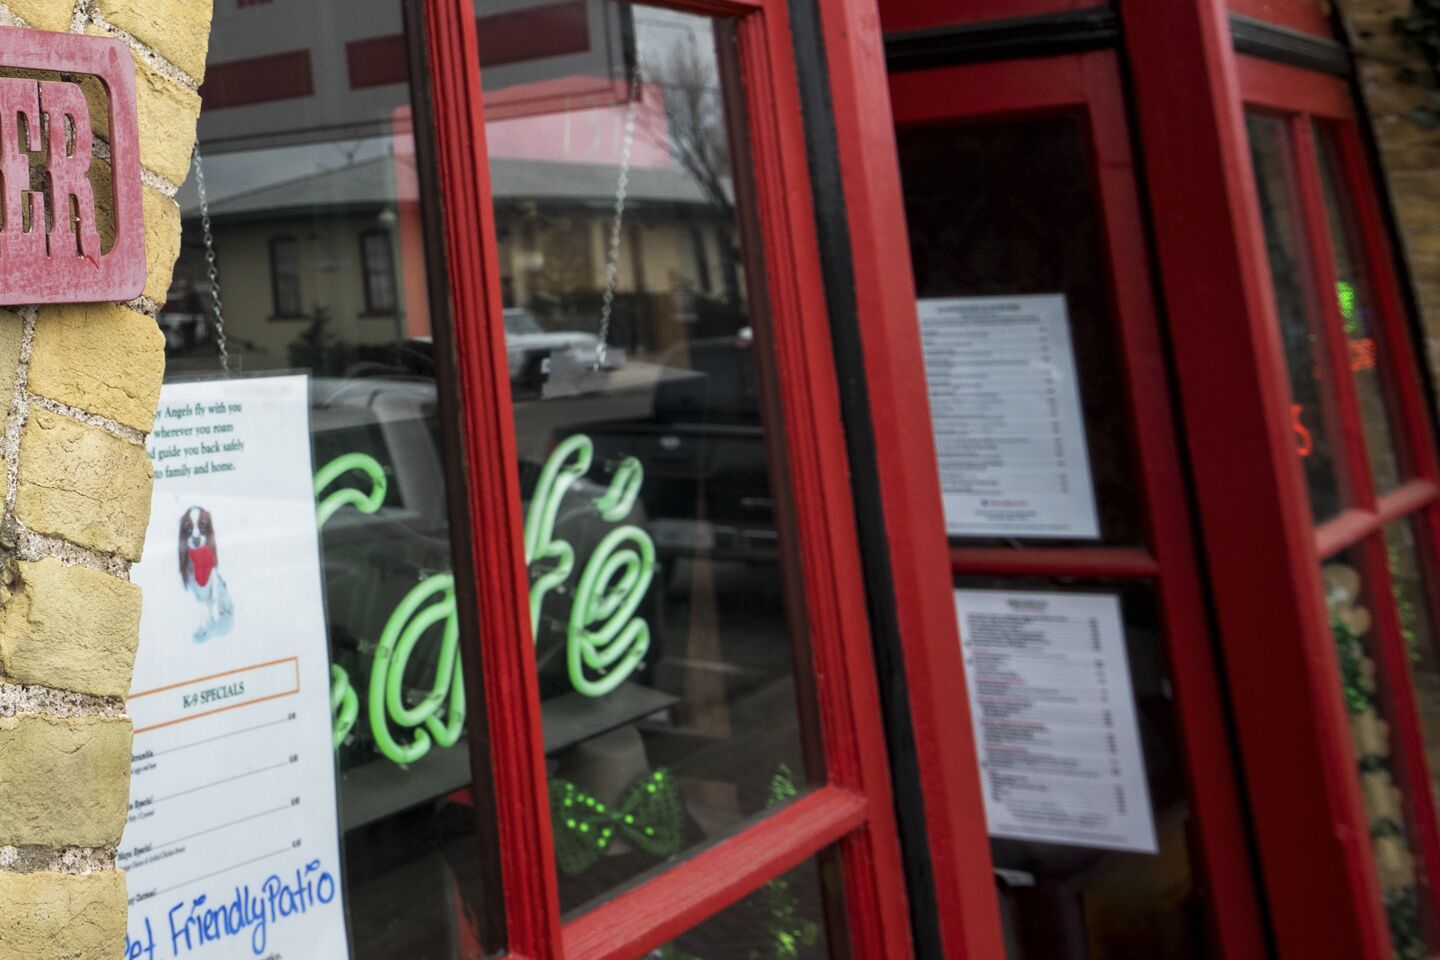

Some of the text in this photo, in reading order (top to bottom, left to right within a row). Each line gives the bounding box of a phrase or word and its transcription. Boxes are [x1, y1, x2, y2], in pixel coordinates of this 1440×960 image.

[164, 403, 193, 420] Angels
[195, 402, 205, 417] fly
[208, 401, 226, 414] with
[228, 403, 242, 415] you
[154, 424, 234, 438] wherever you roam
[158, 445, 181, 461] guide
[184, 446, 199, 459] you
[201, 440, 220, 454] back
[222, 438, 245, 452] safely
[165, 463, 191, 479] family
[194, 461, 209, 474] and
[210, 460, 236, 472] home.
[182, 681, 245, 709] K-9 SPECIALS
[168, 886, 267, 955] Friendly
[260, 859, 335, 924] Patio
